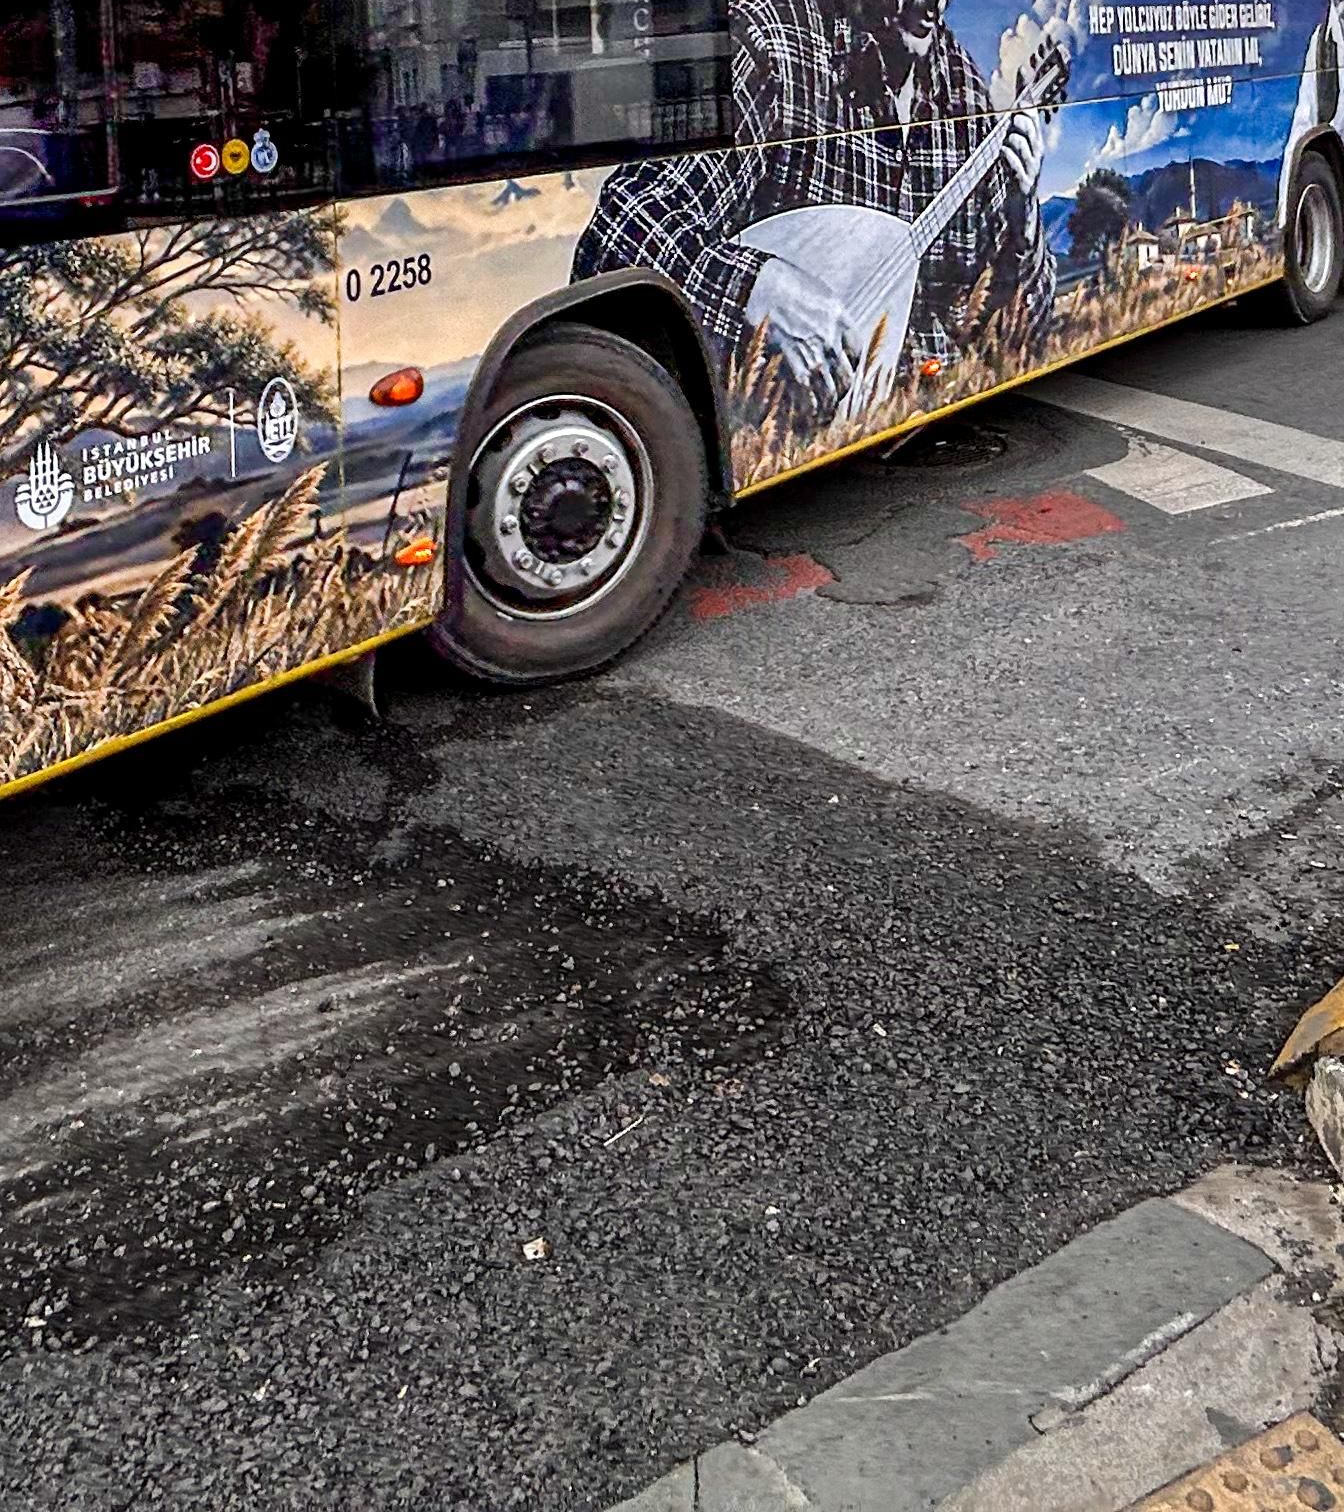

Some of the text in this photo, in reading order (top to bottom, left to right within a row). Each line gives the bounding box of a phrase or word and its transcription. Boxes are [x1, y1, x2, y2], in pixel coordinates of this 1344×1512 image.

[1089, 4, 1114, 35] HEP
[1117, 3, 1174, 34] YOLCUYUZ
[1175, 0, 1207, 31] BÖYLE
[1113, 39, 1157, 76] DÜNYA
[1158, 35, 1196, 73] SENİN
[370, 253, 432, 298] 2258
[82, 436, 212, 486] BÜYÜKŞEHİR
[83, 465, 175, 503] BELEDİYESİ
